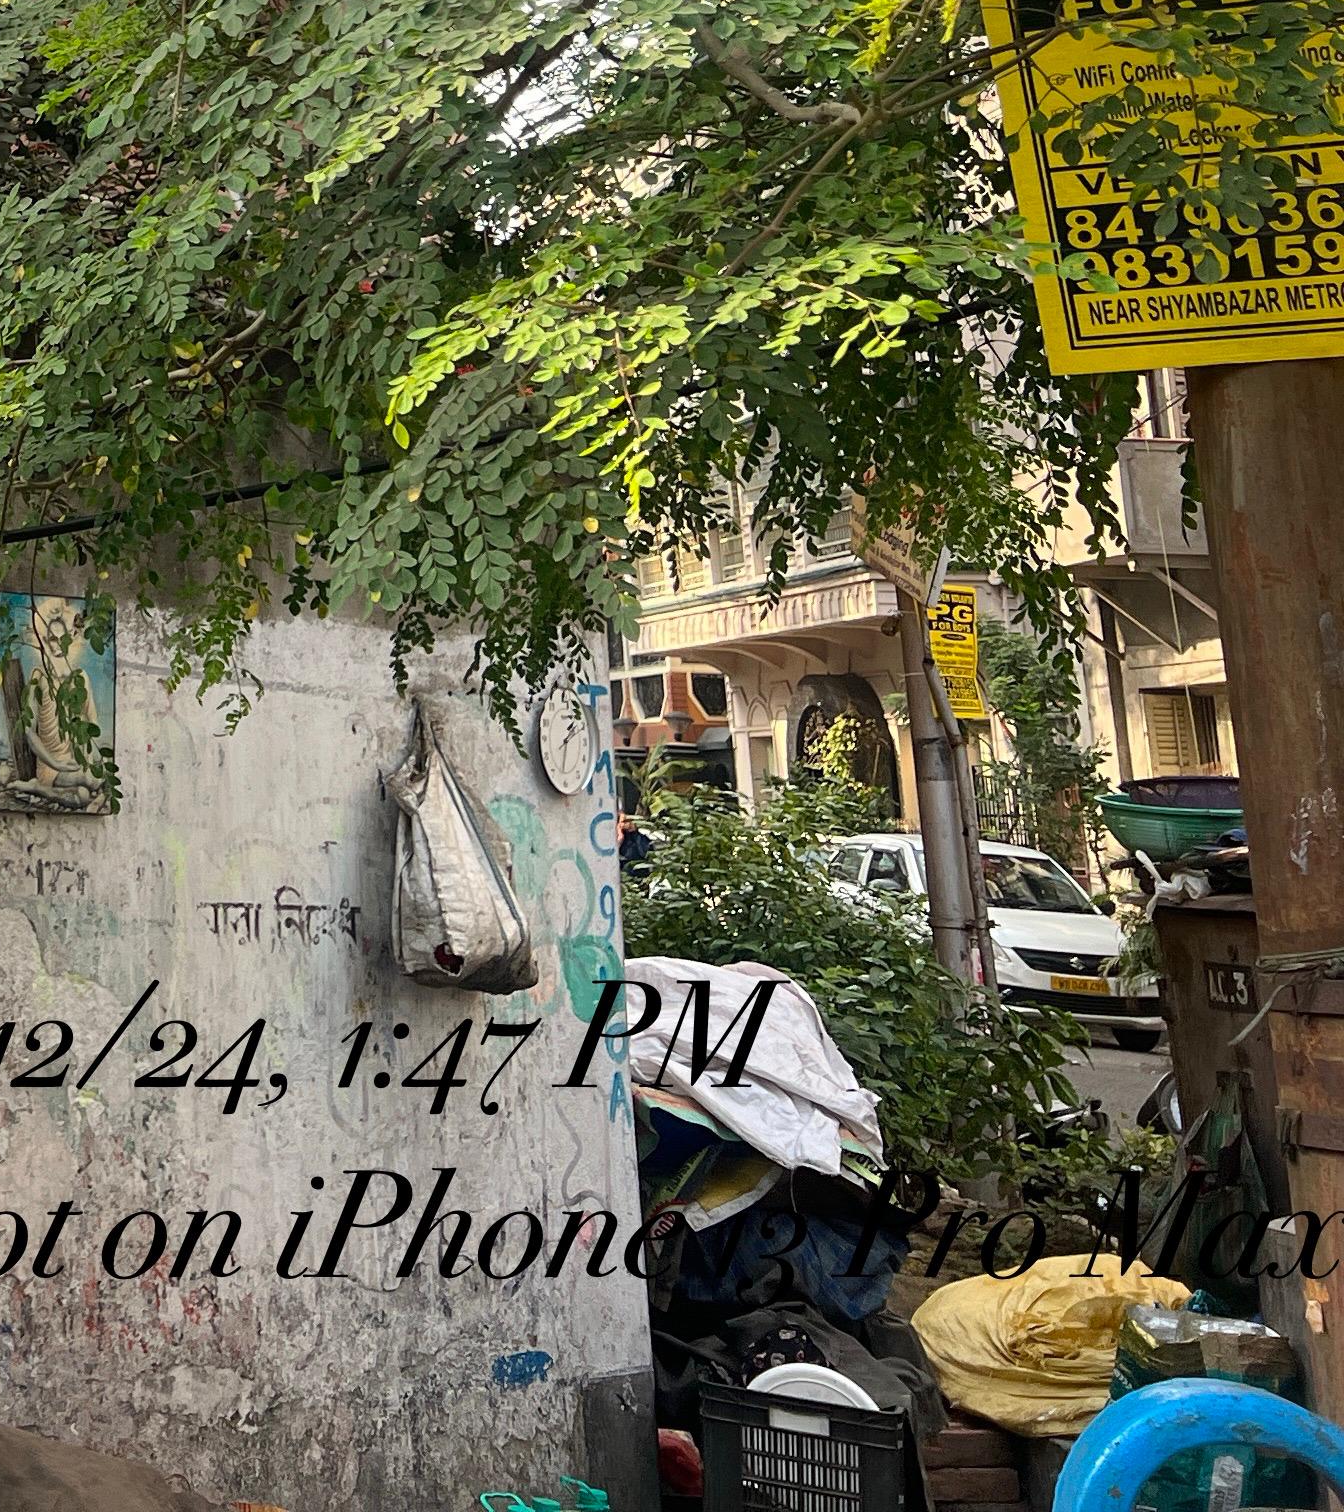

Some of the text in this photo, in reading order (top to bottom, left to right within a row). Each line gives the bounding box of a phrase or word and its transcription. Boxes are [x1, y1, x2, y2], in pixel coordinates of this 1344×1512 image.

[1074, 63, 1116, 90] WiFi
[1088, 281, 1344, 326] NEAR SHYAMBAZAR METR
[927, 602, 974, 624] PG
